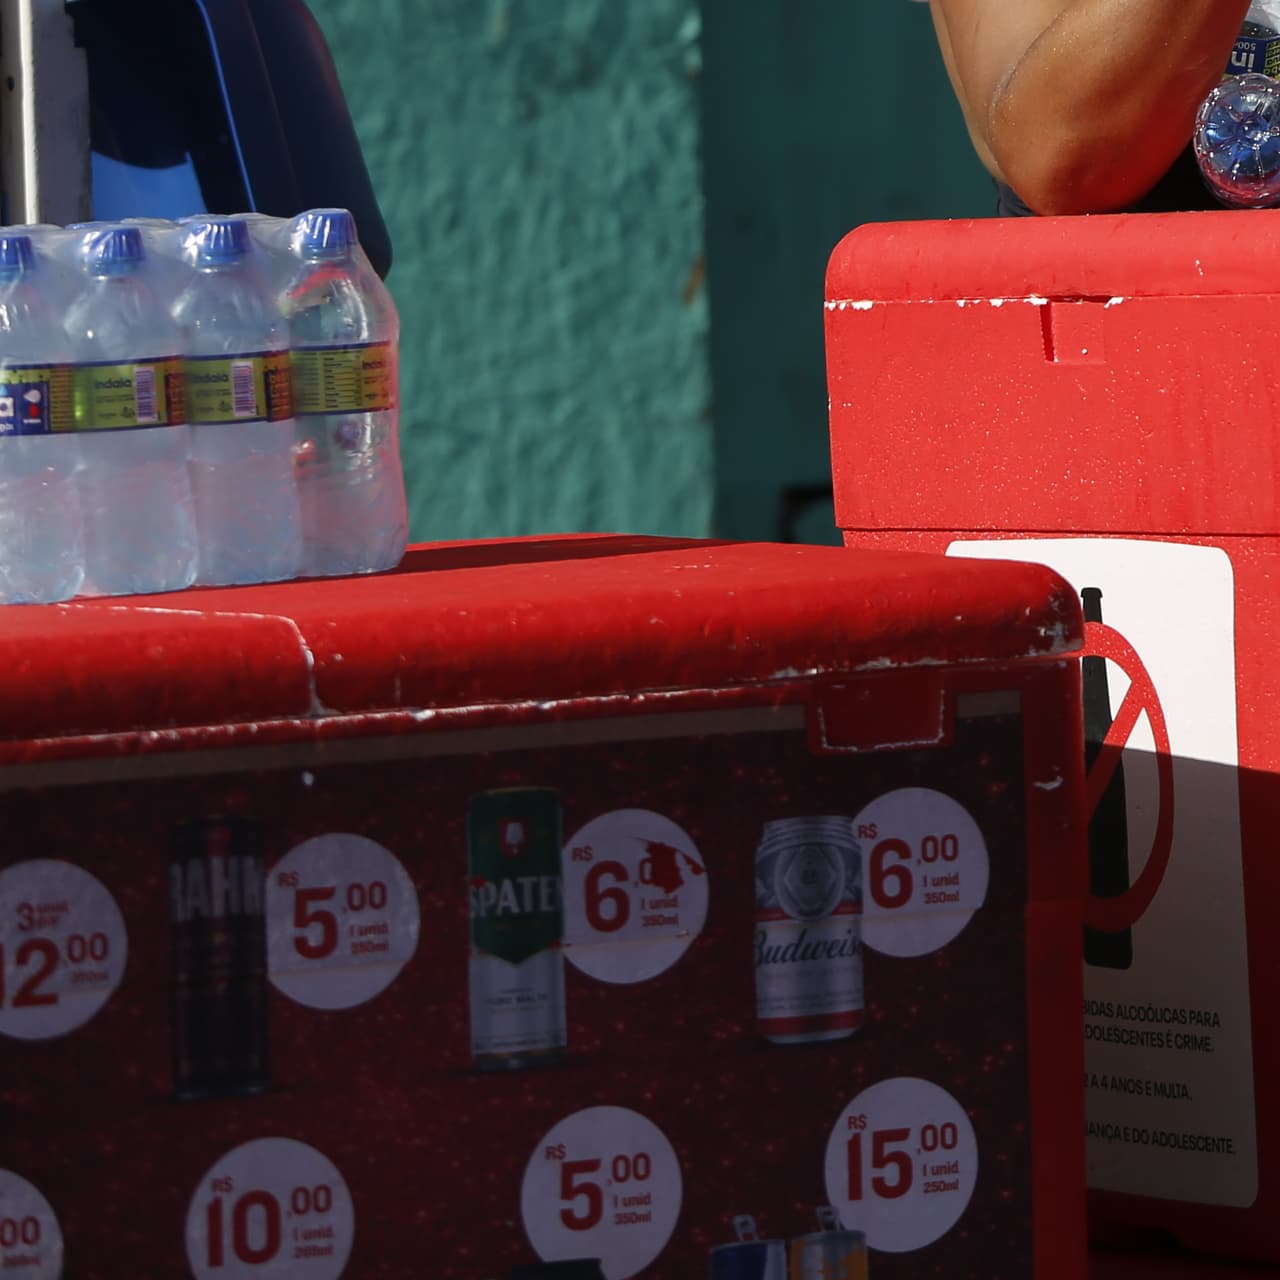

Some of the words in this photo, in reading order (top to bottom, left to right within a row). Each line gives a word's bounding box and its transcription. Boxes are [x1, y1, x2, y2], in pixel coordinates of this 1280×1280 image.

[858, 823, 878, 840] R$
[572, 846, 592, 862] R$
[279, 871, 299, 887] R$
[16, 902, 35, 932] 3
[1189, 1009, 1222, 1029] PARA
[1166, 1029, 1174, 1050] É
[1174, 1033, 1215, 1053] CRIME.
[1091, 1074, 1099, 1089] A
[1100, 1075, 1109, 1090] 4
[1110, 1077, 1144, 1096] ANOS
[1145, 1080, 1153, 1097] E
[1153, 1081, 1193, 1101] MULTA.
[848, 1115, 867, 1130] R$
[1123, 1125, 1131, 1143] E
[1132, 1127, 1150, 1145] DO
[1151, 1130, 1237, 1155] ADOLESCENTE.
[545, 1144, 566, 1161] R$
